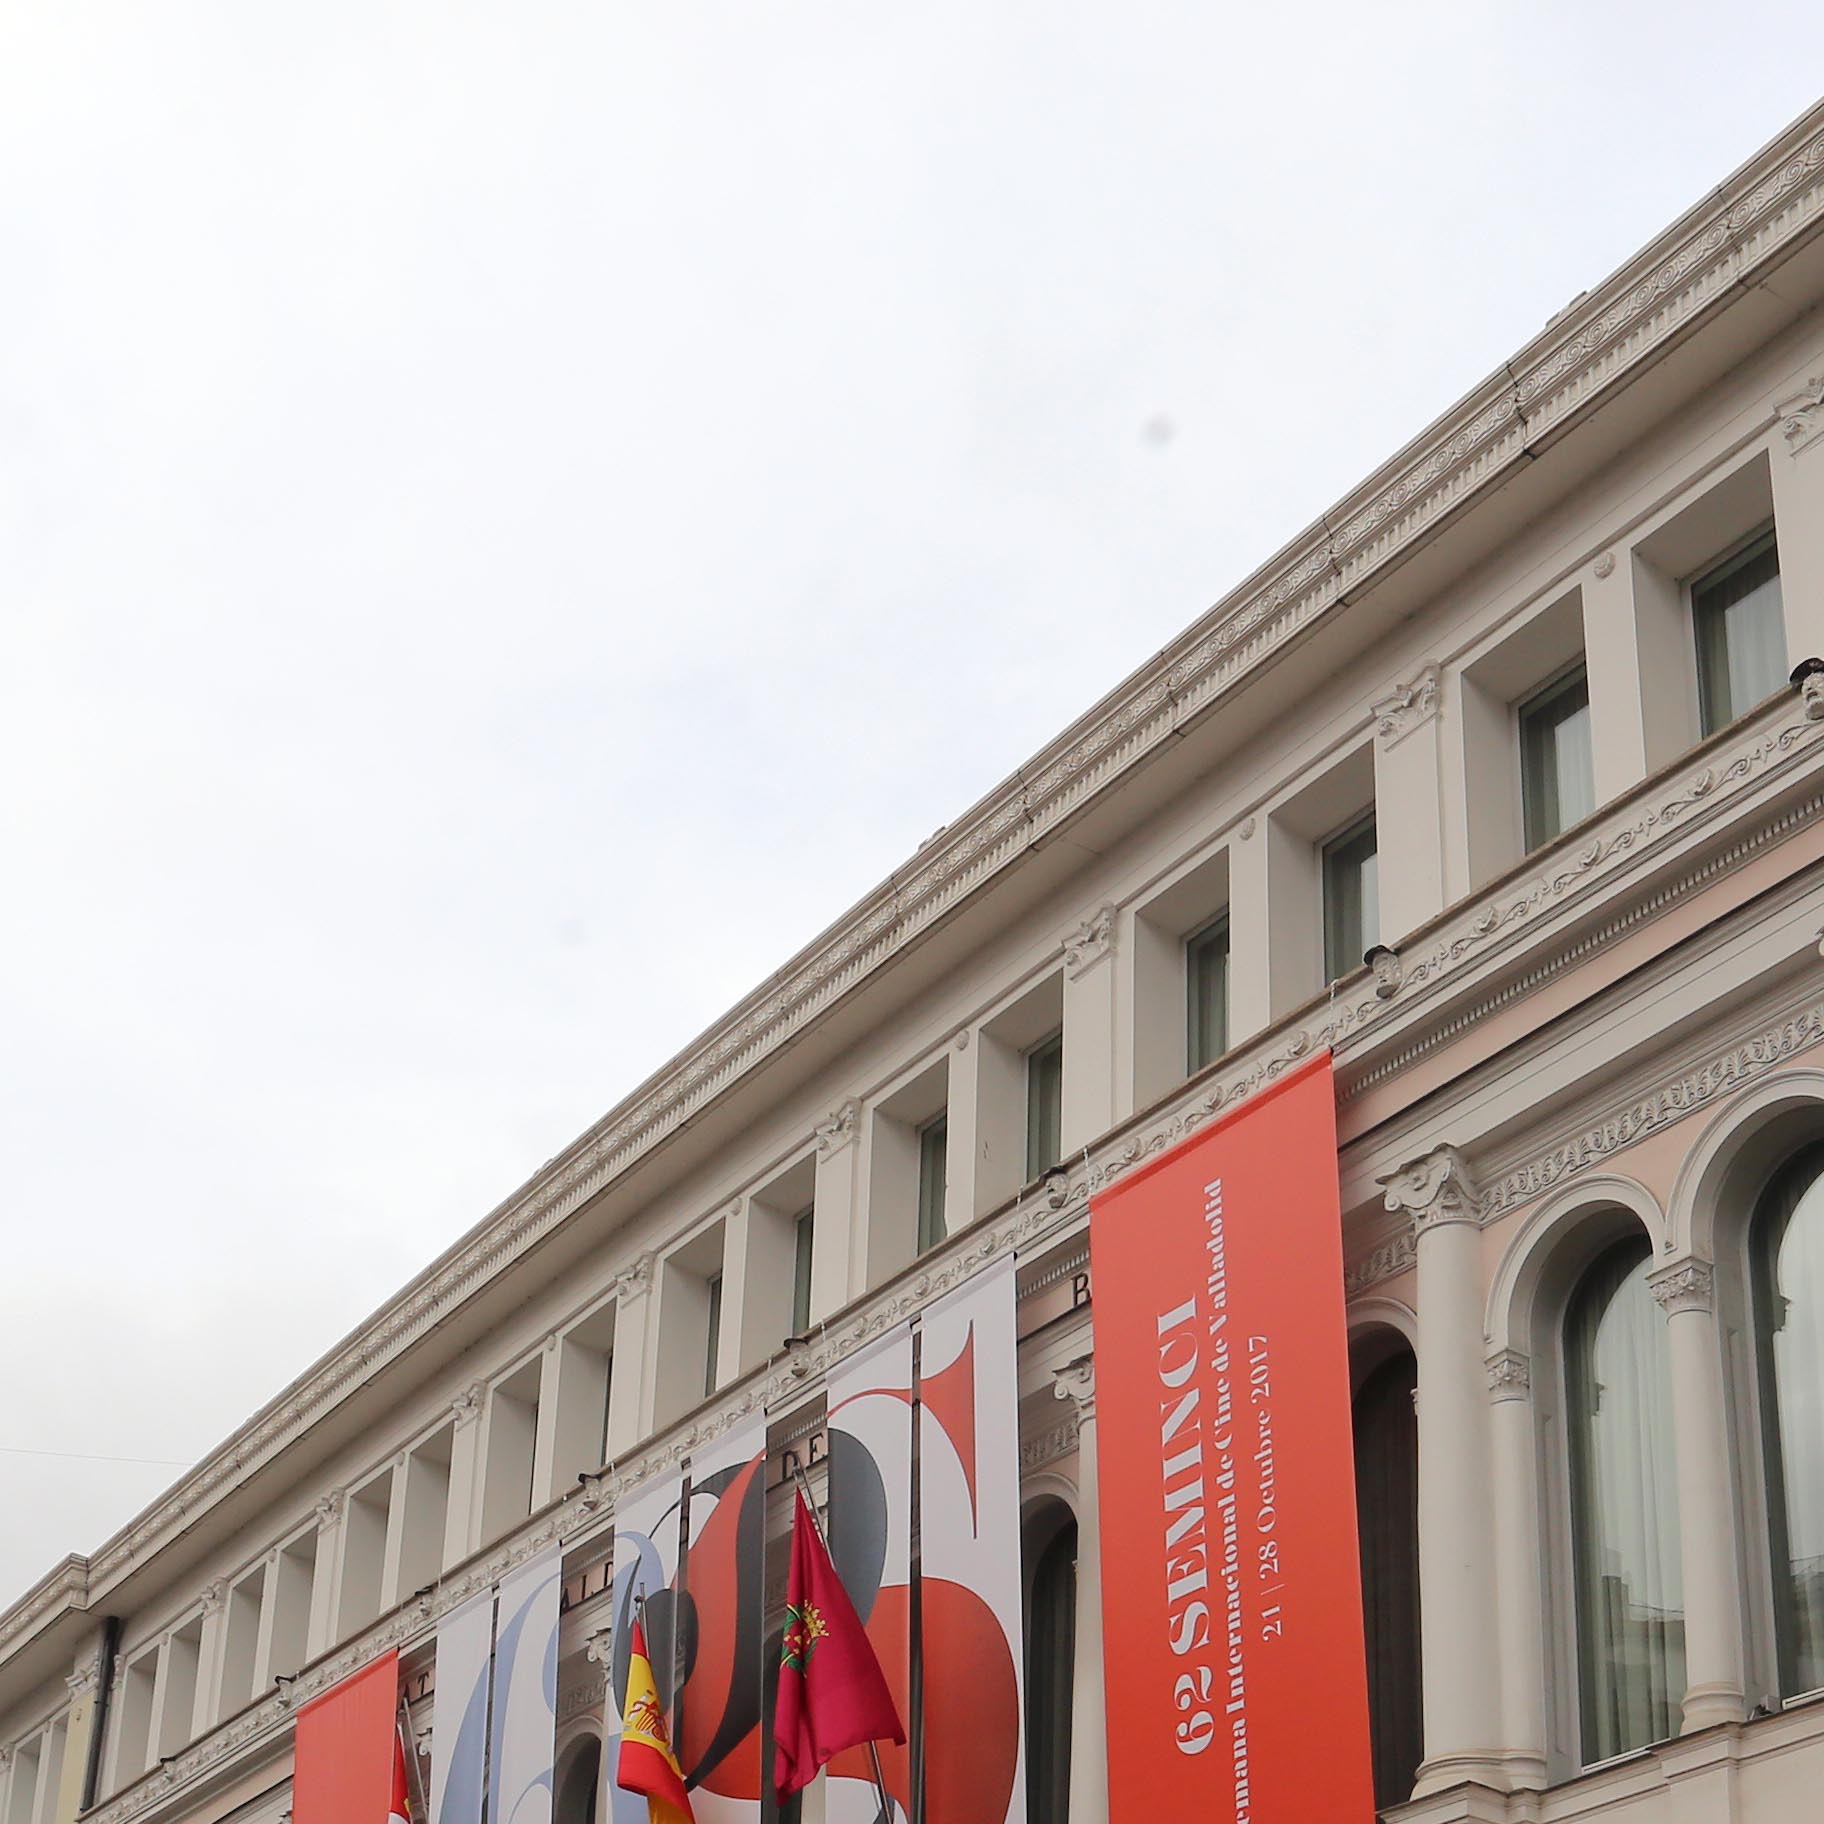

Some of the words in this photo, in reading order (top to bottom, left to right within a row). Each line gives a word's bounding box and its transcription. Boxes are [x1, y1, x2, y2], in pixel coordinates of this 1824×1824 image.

[1204, 1177, 1228, 1335] Valladolid
[1211, 1337, 1229, 1372] de
[1248, 1335, 1269, 1404] 2017
[1214, 1379, 1232, 1450] Cine
[1157, 1292, 1210, 1655] SEMINCI
[1216, 1453, 1235, 1489] de
[1254, 1408, 1278, 1533] Octubre
[1259, 1540, 1280, 1580] 28
[1217, 1493, 1246, 1714] Internacional
[1263, 1604, 1282, 1642] 21
[1175, 1666, 1214, 1755] 62
